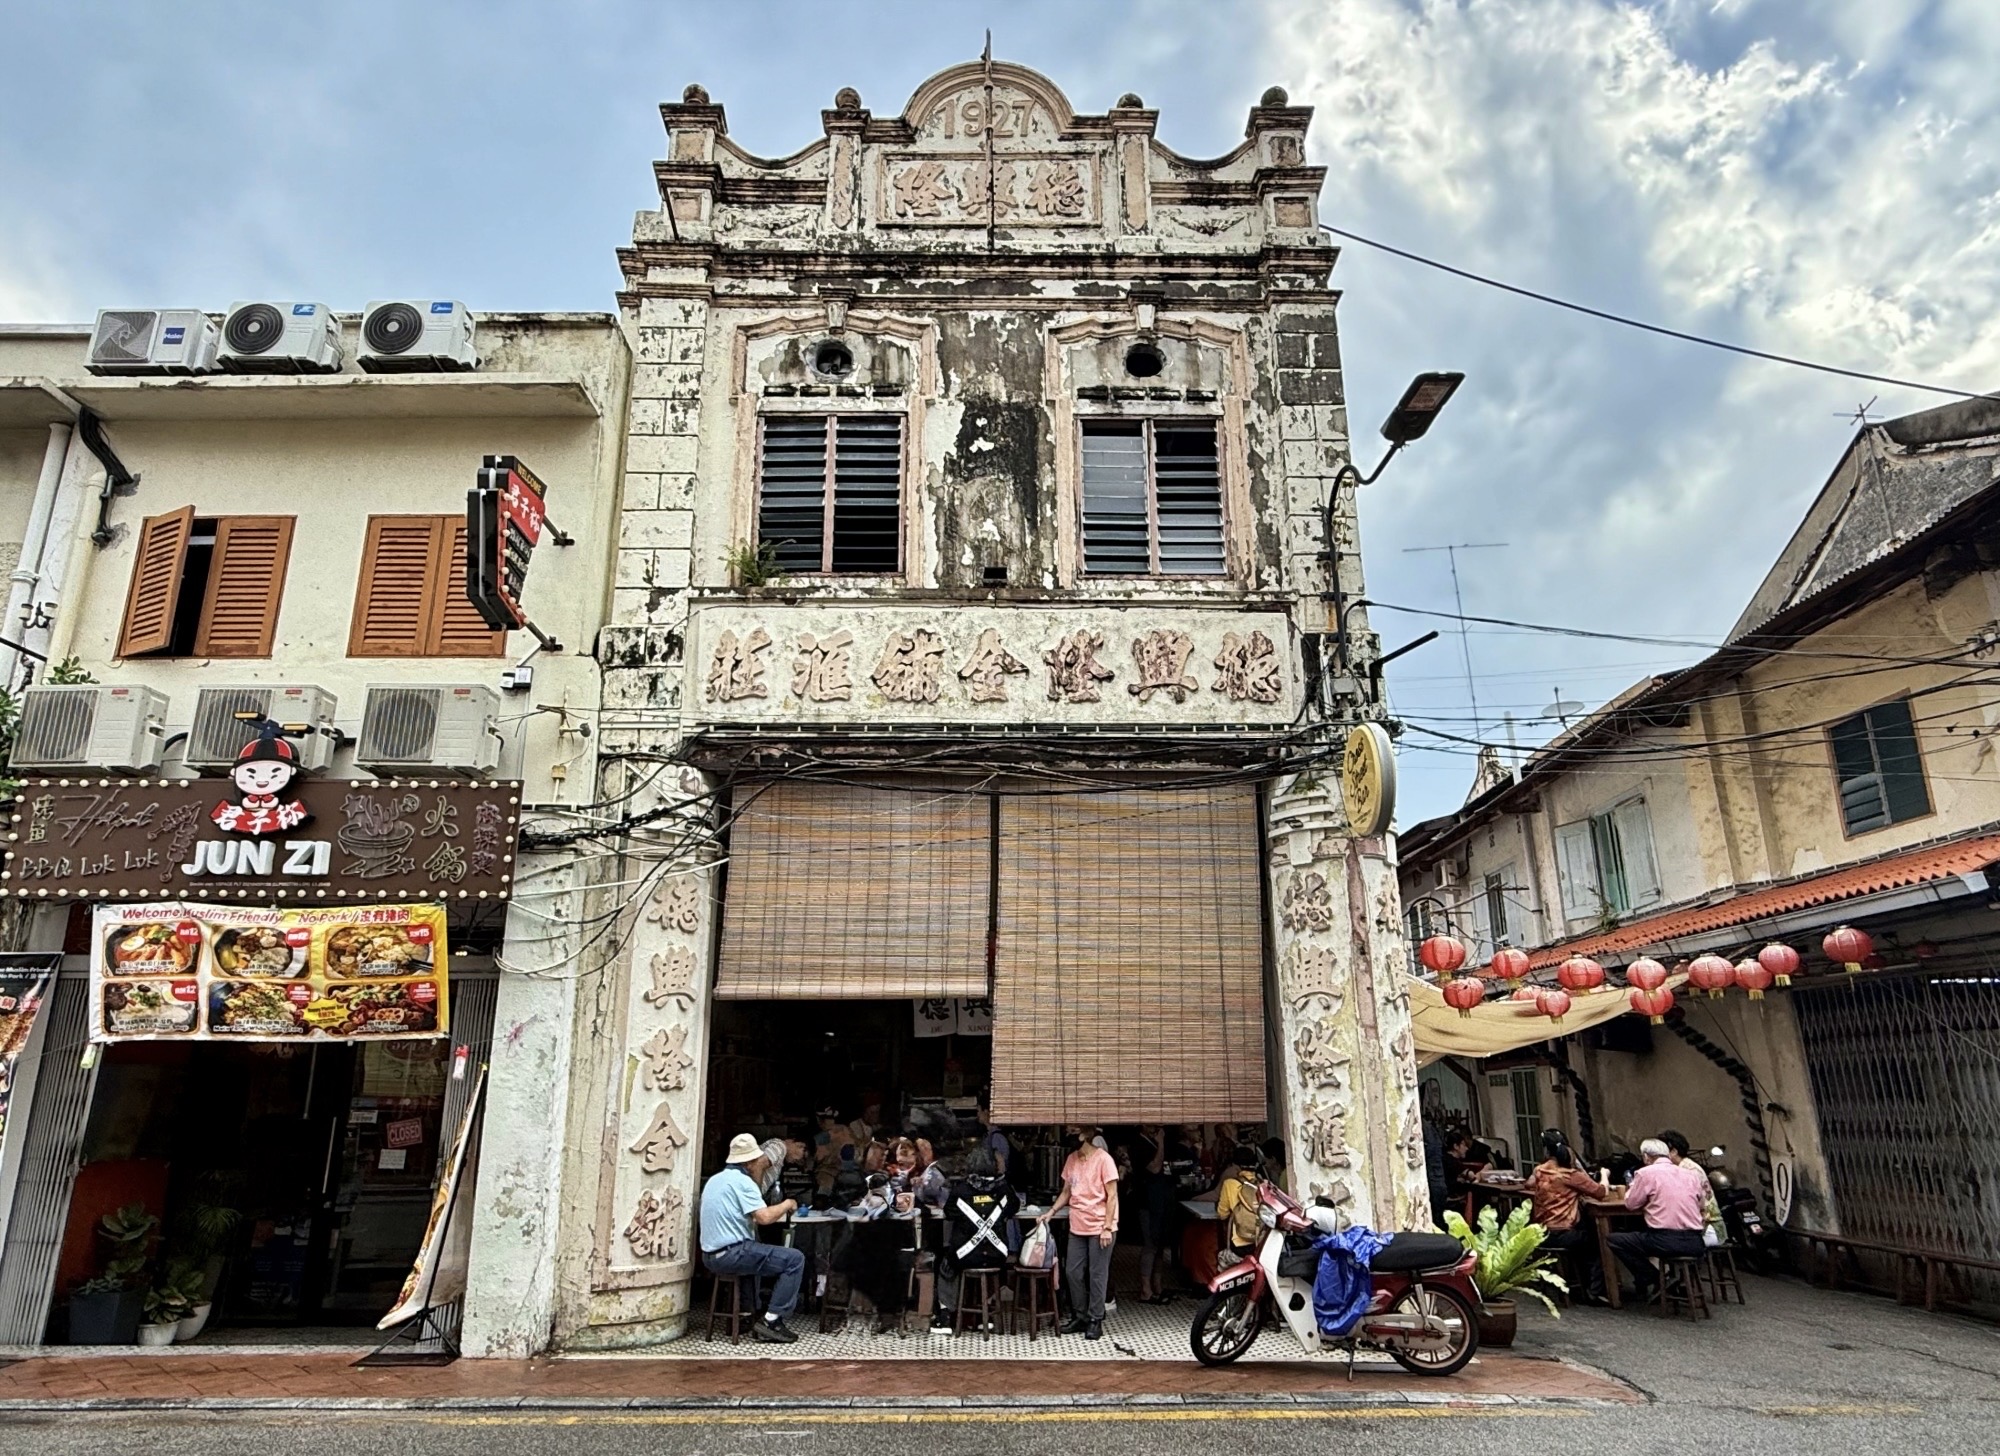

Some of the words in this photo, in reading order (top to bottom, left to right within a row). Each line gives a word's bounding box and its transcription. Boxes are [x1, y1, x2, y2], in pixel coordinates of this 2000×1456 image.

[937, 98, 1036, 139] 1927
[517, 463, 542, 495] WELCOME
[19, 856, 73, 879] BBQ
[80, 853, 116, 876] Lok
[124, 848, 160, 870] Lok
[181, 840, 276, 877] JUN
[282, 840, 332, 876] ZI
[122, 907, 181, 920] Welcome
[229, 911, 284, 925] Friendly
[298, 913, 317, 924] No
[320, 912, 349, 923] Pork
[967, 1024, 991, 1032] XING
[389, 1124, 420, 1143] CLOSED
